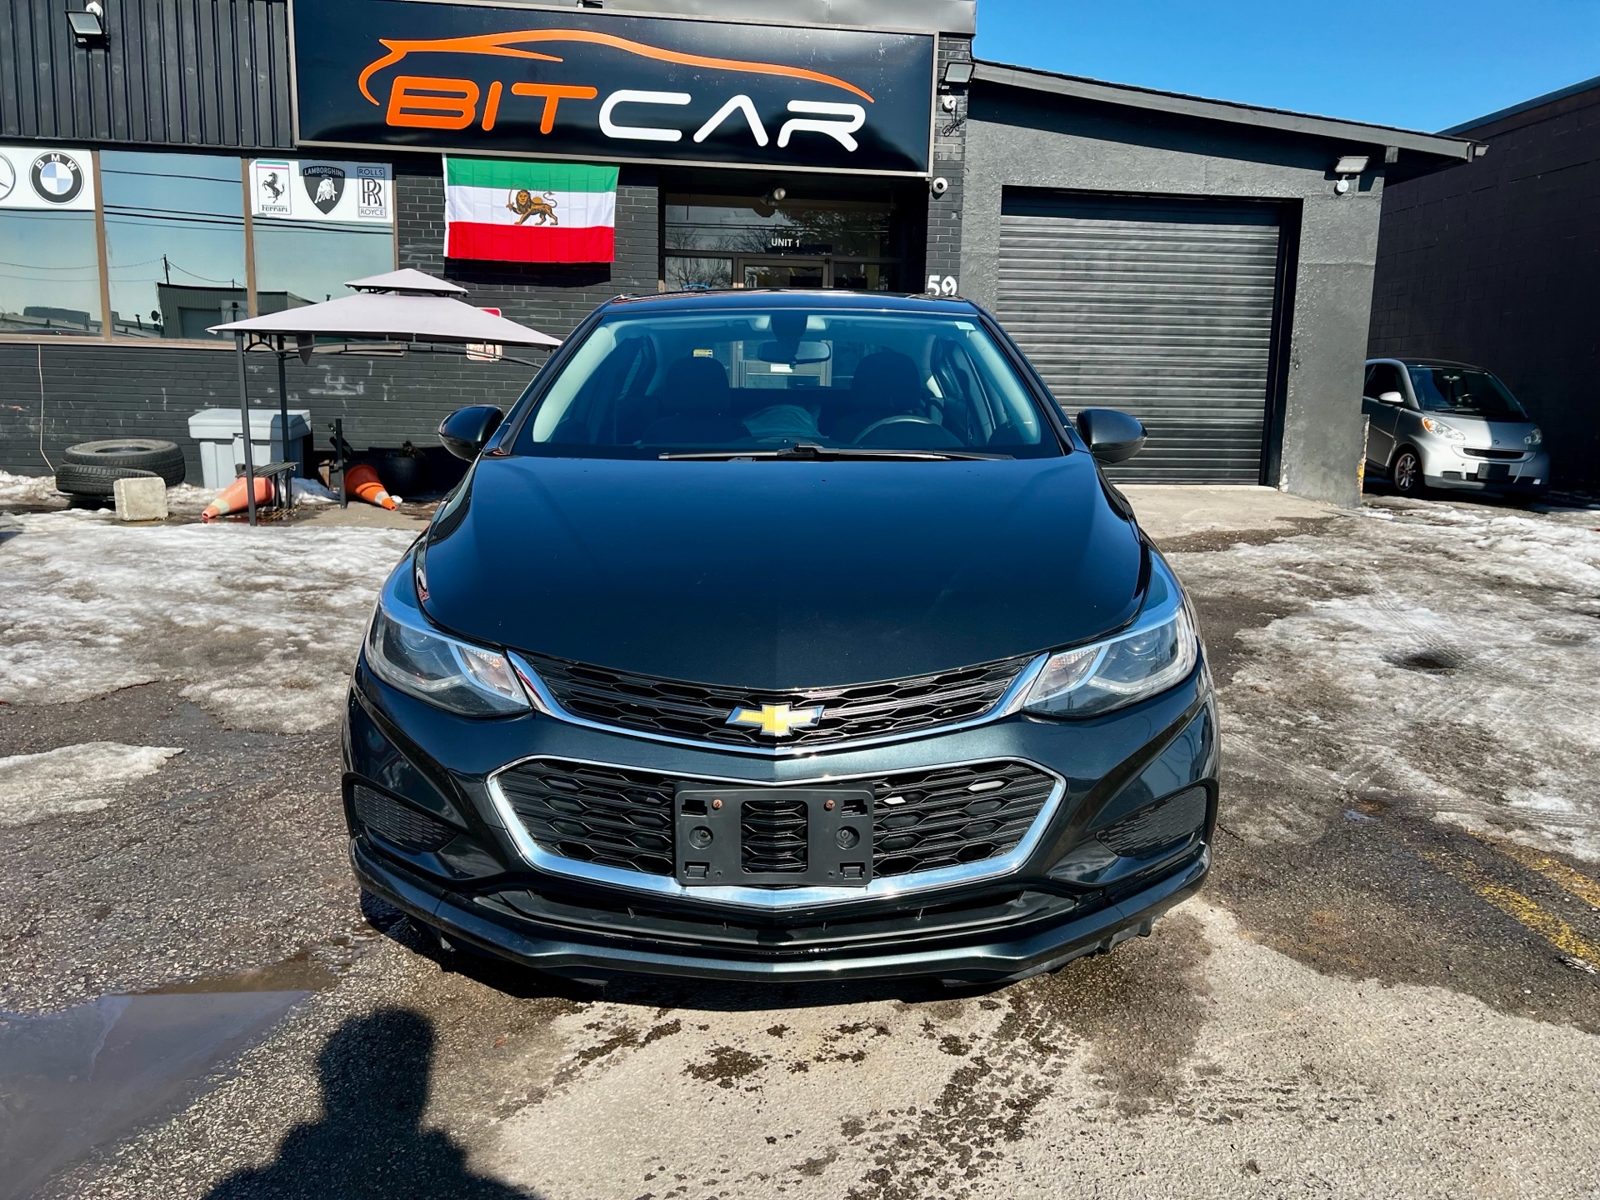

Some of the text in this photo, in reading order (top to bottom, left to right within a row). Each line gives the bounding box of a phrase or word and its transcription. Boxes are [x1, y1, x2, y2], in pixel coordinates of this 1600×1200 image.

[35, 153, 78, 172] BMW
[303, 166, 345, 178] LAMBORGHINI
[358, 168, 384, 176] ROLLS
[261, 204, 289, 213] Ferrari
[360, 207, 384, 216] ROYCE
[771, 238, 800, 248] UNIT 1
[927, 274, 958, 297] 59
